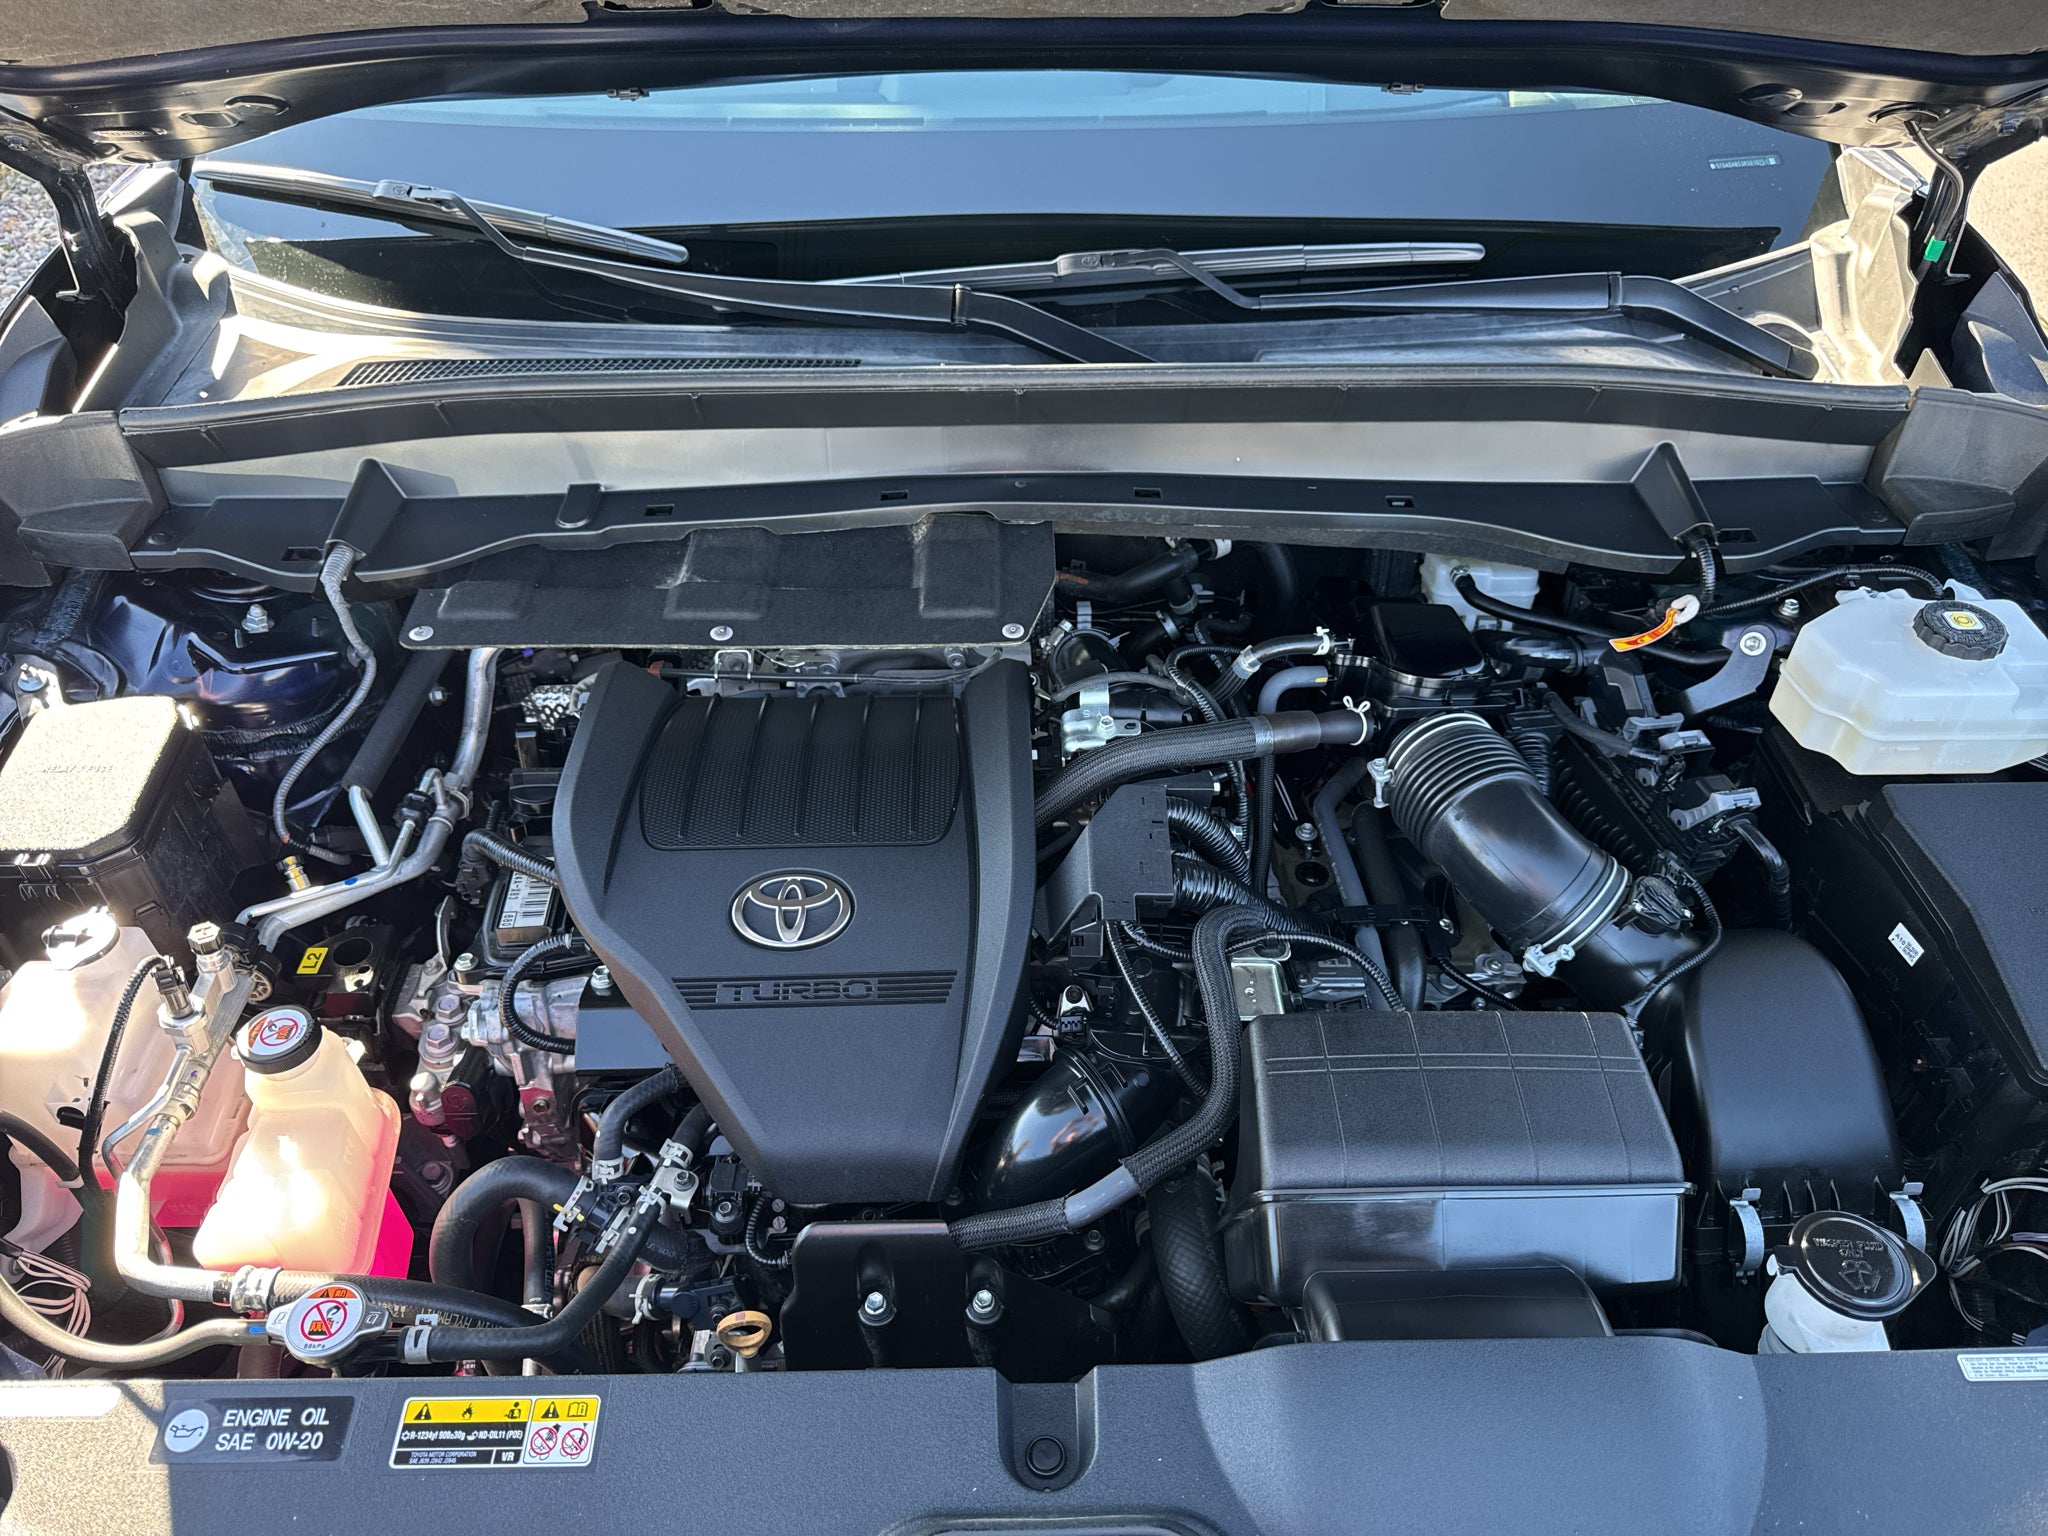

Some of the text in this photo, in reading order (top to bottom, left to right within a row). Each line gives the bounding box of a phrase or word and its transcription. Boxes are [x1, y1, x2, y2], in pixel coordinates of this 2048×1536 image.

[302, 953, 322, 969] L2
[722, 980, 874, 1001] TURBO
[222, 1408, 330, 1427] ENGINE OIL
[215, 1432, 324, 1451] SAE 0W-20
[445, 1450, 477, 1458] CORPORATION
[501, 1451, 515, 1462] VR
